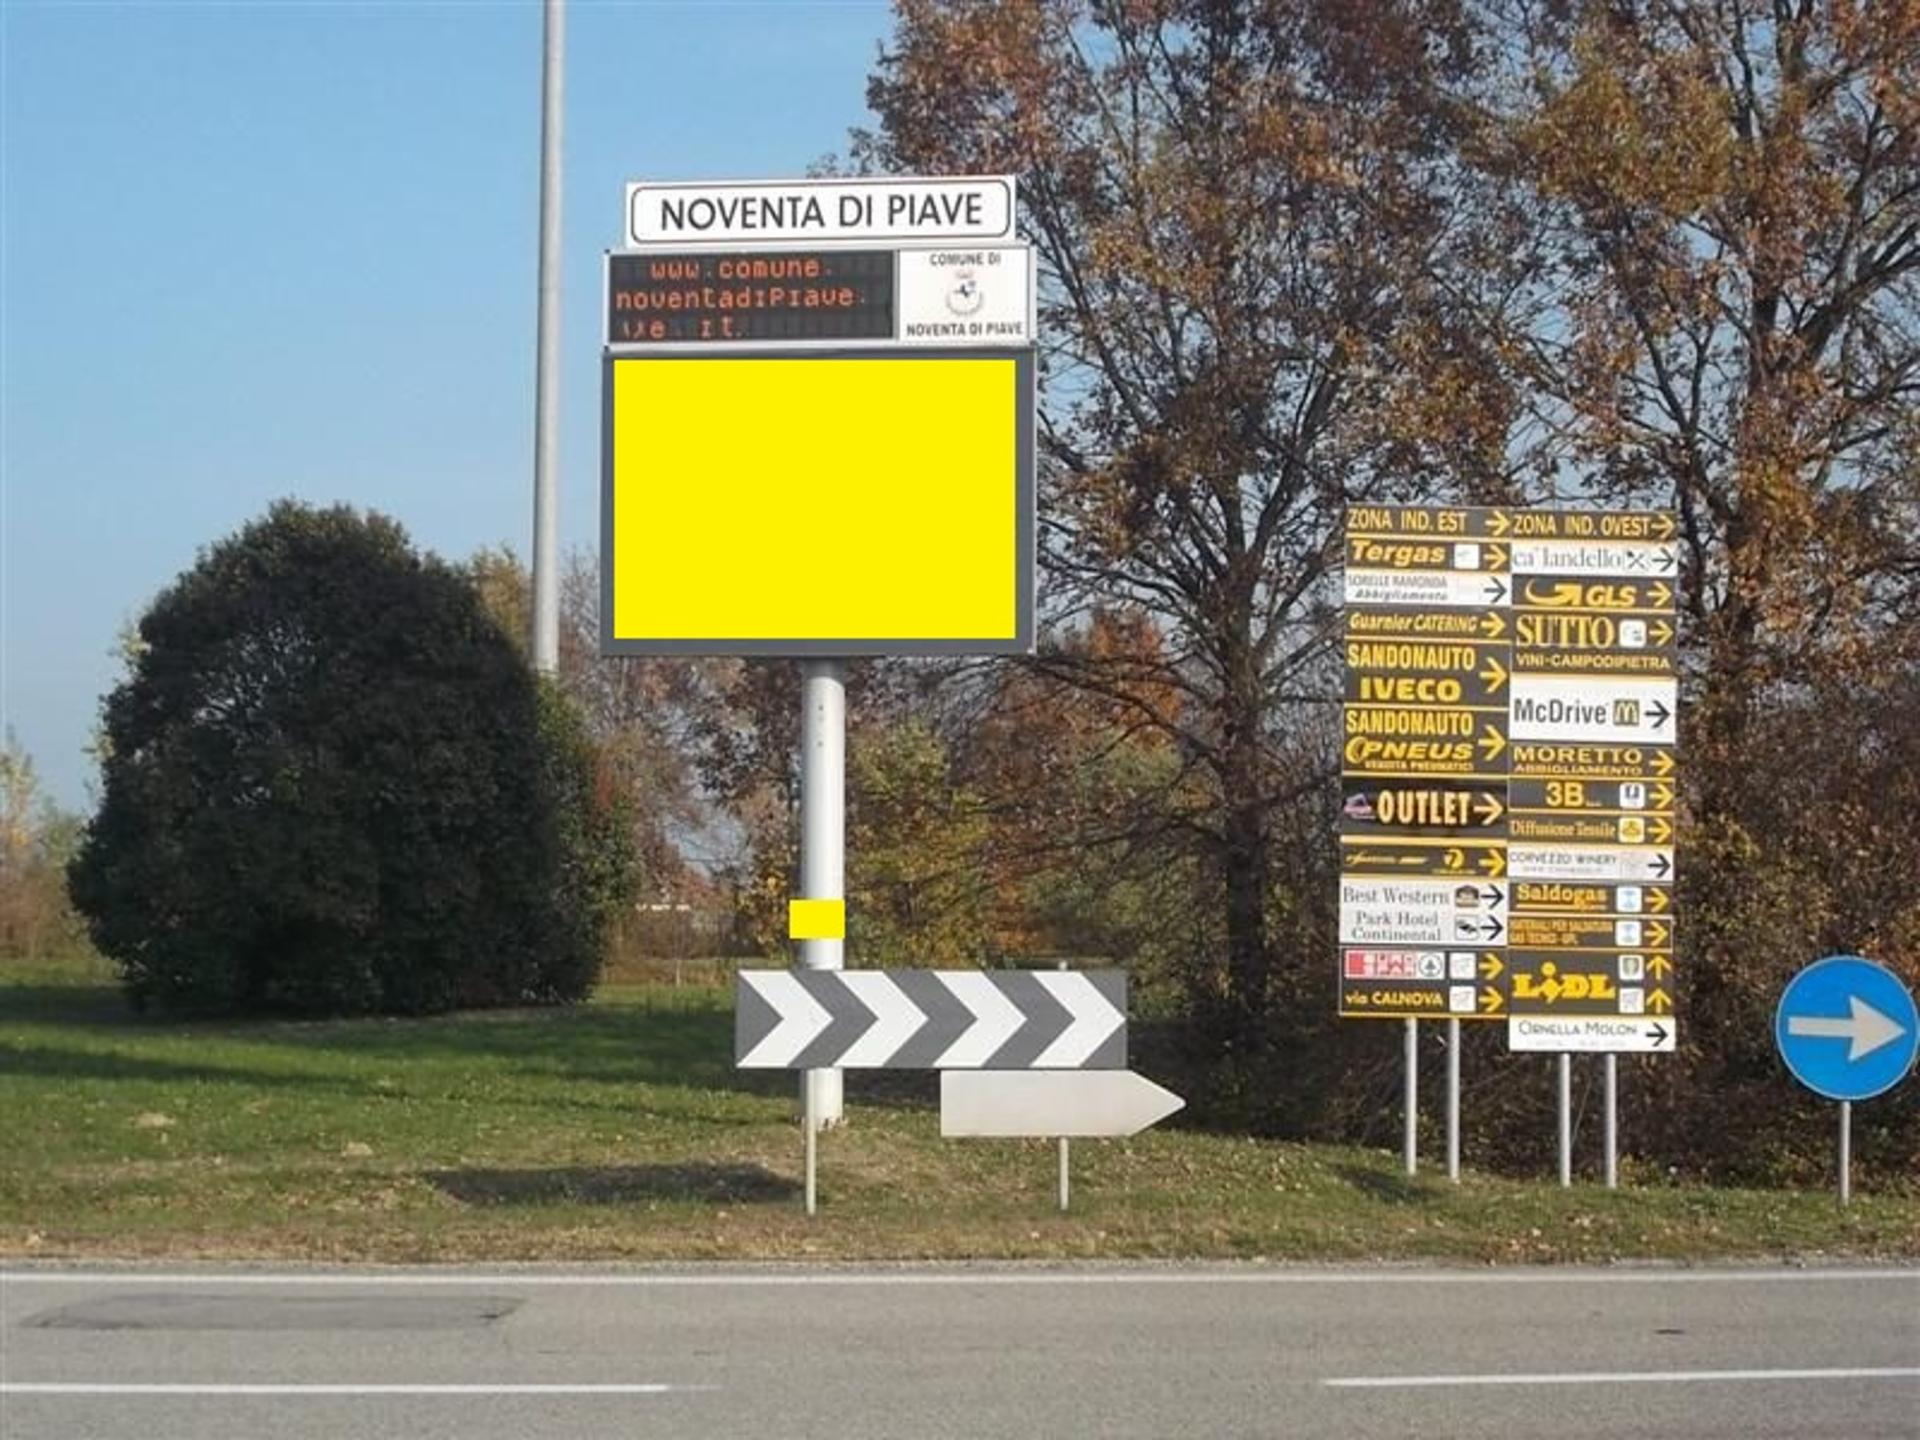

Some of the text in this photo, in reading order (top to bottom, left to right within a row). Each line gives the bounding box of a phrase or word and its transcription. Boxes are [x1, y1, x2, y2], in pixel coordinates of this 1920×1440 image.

[661, 193, 982, 230] NOVENTA DI PIAVE
[930, 252, 1001, 266] COMUNE DI
[907, 322, 1022, 336] NOVENTA DI PIAVE
[1348, 509, 1467, 532] ZONA IND. EST
[1514, 516, 1650, 536] ZONA IND. OVEST
[1352, 540, 1445, 567] Tergas
[1587, 585, 1636, 606] GLS
[1516, 615, 1614, 648] SUTTO
[1348, 644, 1475, 671] SANDONAUTO
[1360, 677, 1461, 702] IVECO
[1346, 710, 1473, 735] SANDONAUTO
[1514, 699, 1606, 724] McDrive
[1514, 747, 1642, 763] MORETTO
[1546, 782, 1584, 807] 3B
[1377, 790, 1471, 824] OUTLET
[1344, 887, 1449, 904] Best Western
[1518, 884, 1607, 906] Saldogas
[1356, 911, 1438, 926] Park Hotel
[1352, 928, 1441, 941] Continental
[1346, 991, 1443, 1005] via CALNOVA
